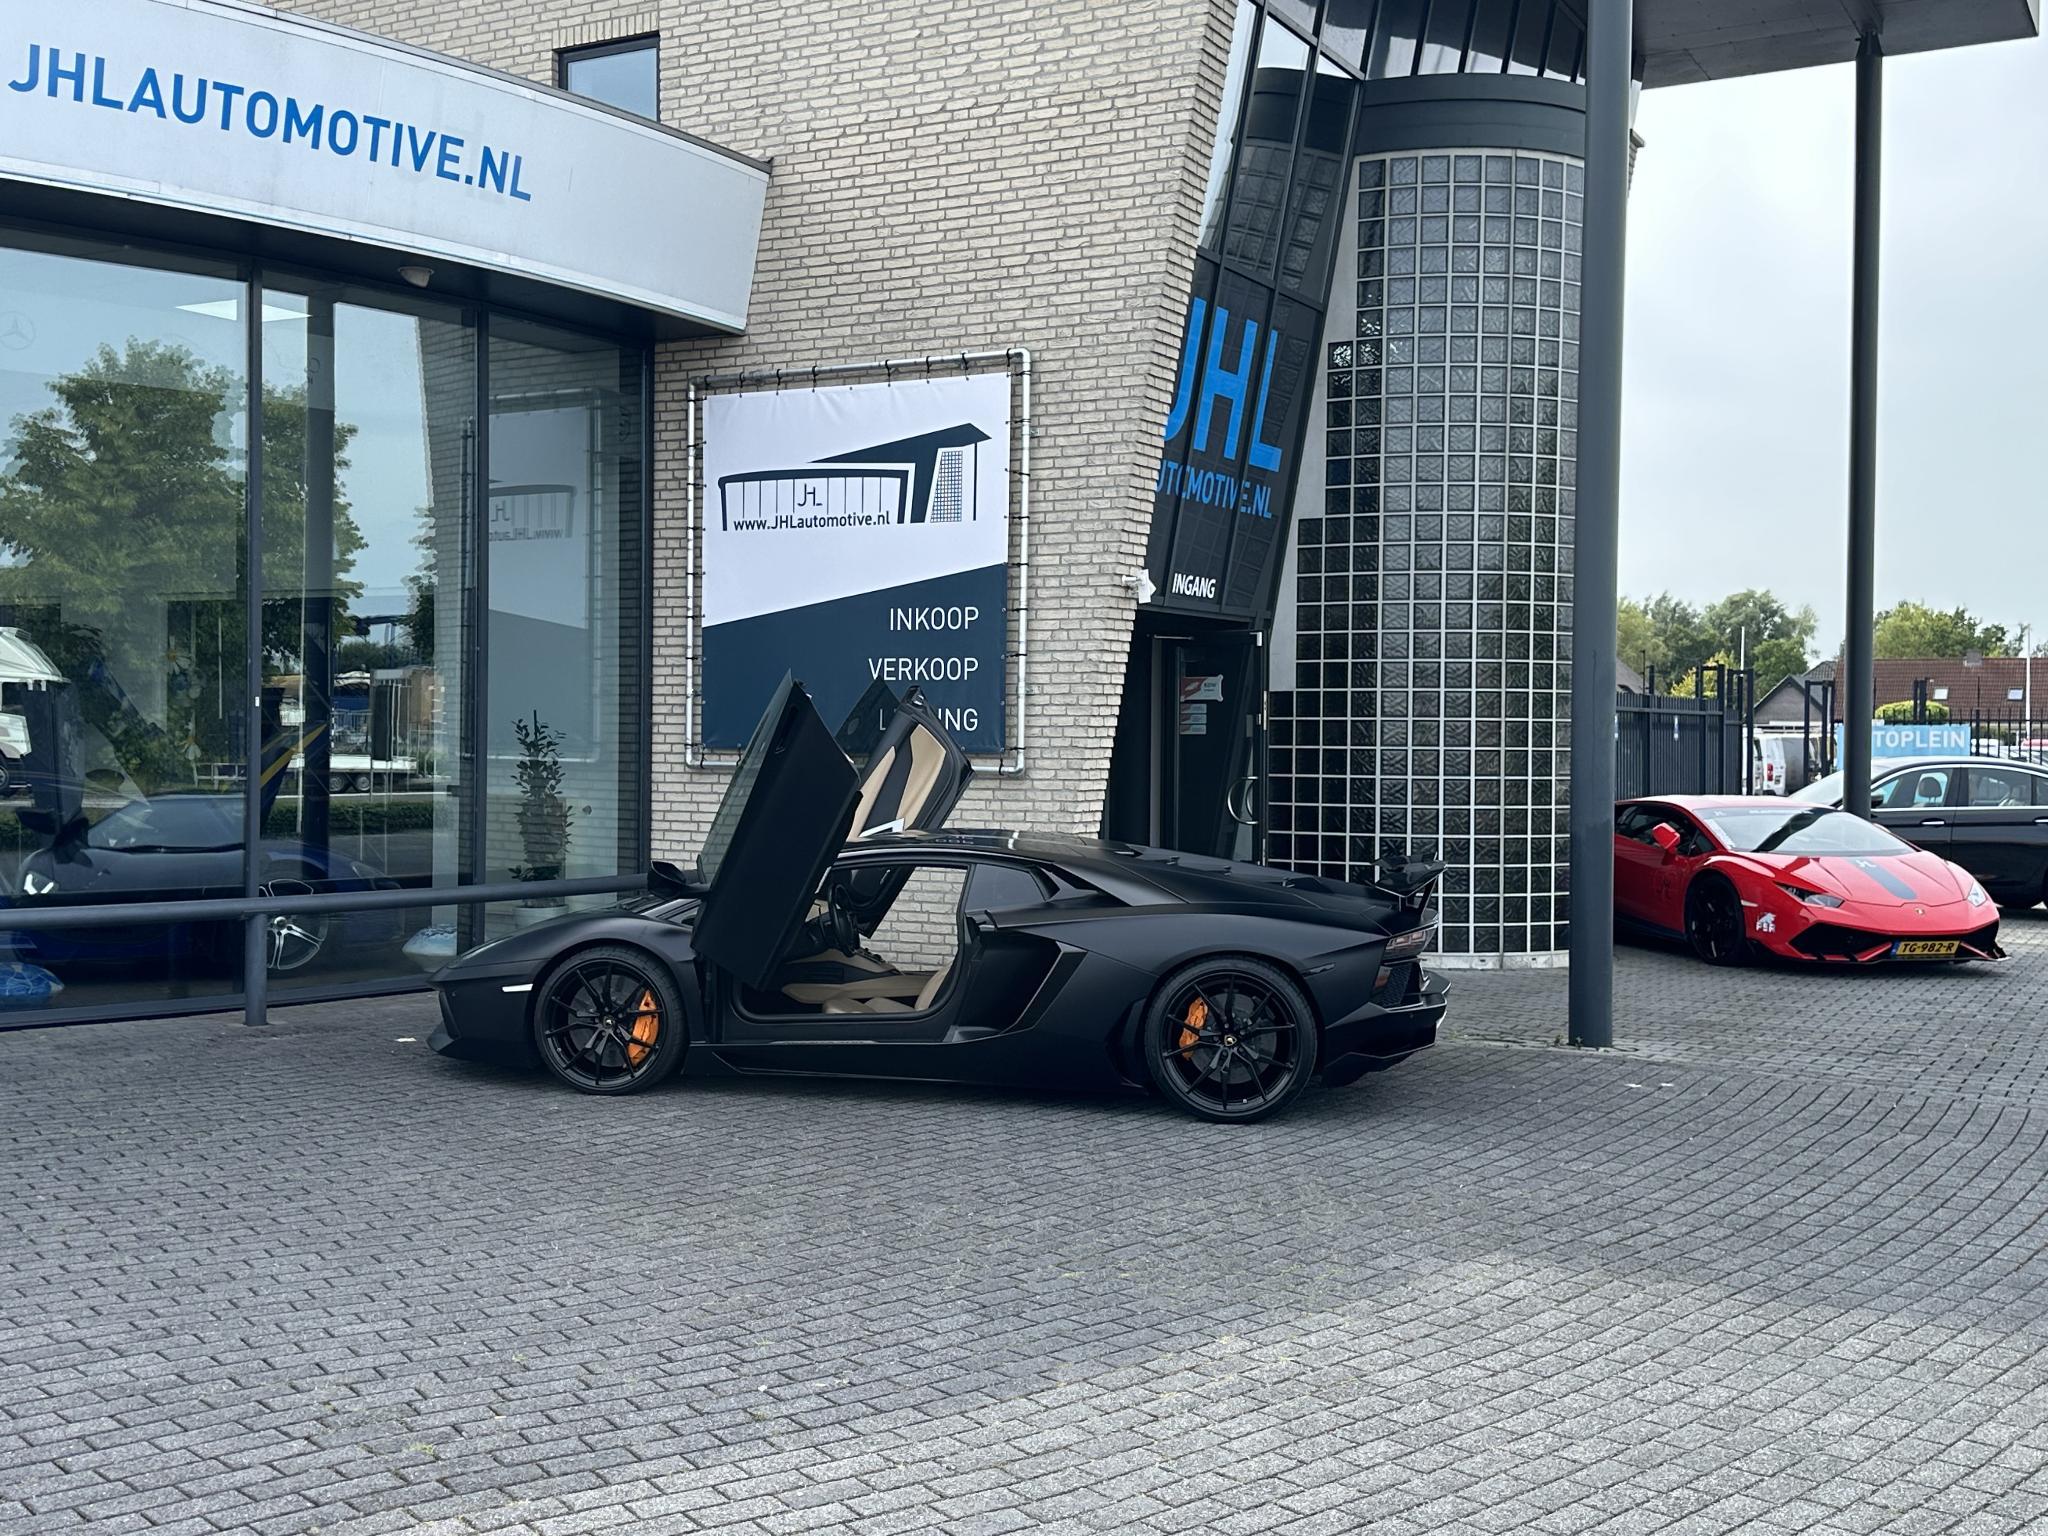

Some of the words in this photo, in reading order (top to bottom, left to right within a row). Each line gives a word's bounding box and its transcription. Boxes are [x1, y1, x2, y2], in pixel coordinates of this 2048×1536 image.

[8, 43, 532, 202] JHLAUTOMOTIVE.NL
[1165, 296, 1283, 473] JHL
[1156, 459, 1272, 519] UTOMOTIVE.NL
[733, 510, 891, 531] www.JHLautomotive.nl
[1172, 572, 1217, 599] INGANG
[889, 606, 980, 631] INKOOP
[868, 657, 979, 681] VERKOOP
[1872, 730, 1965, 748] TOPLEIN
[1902, 942, 1955, 953] TG-982-R
